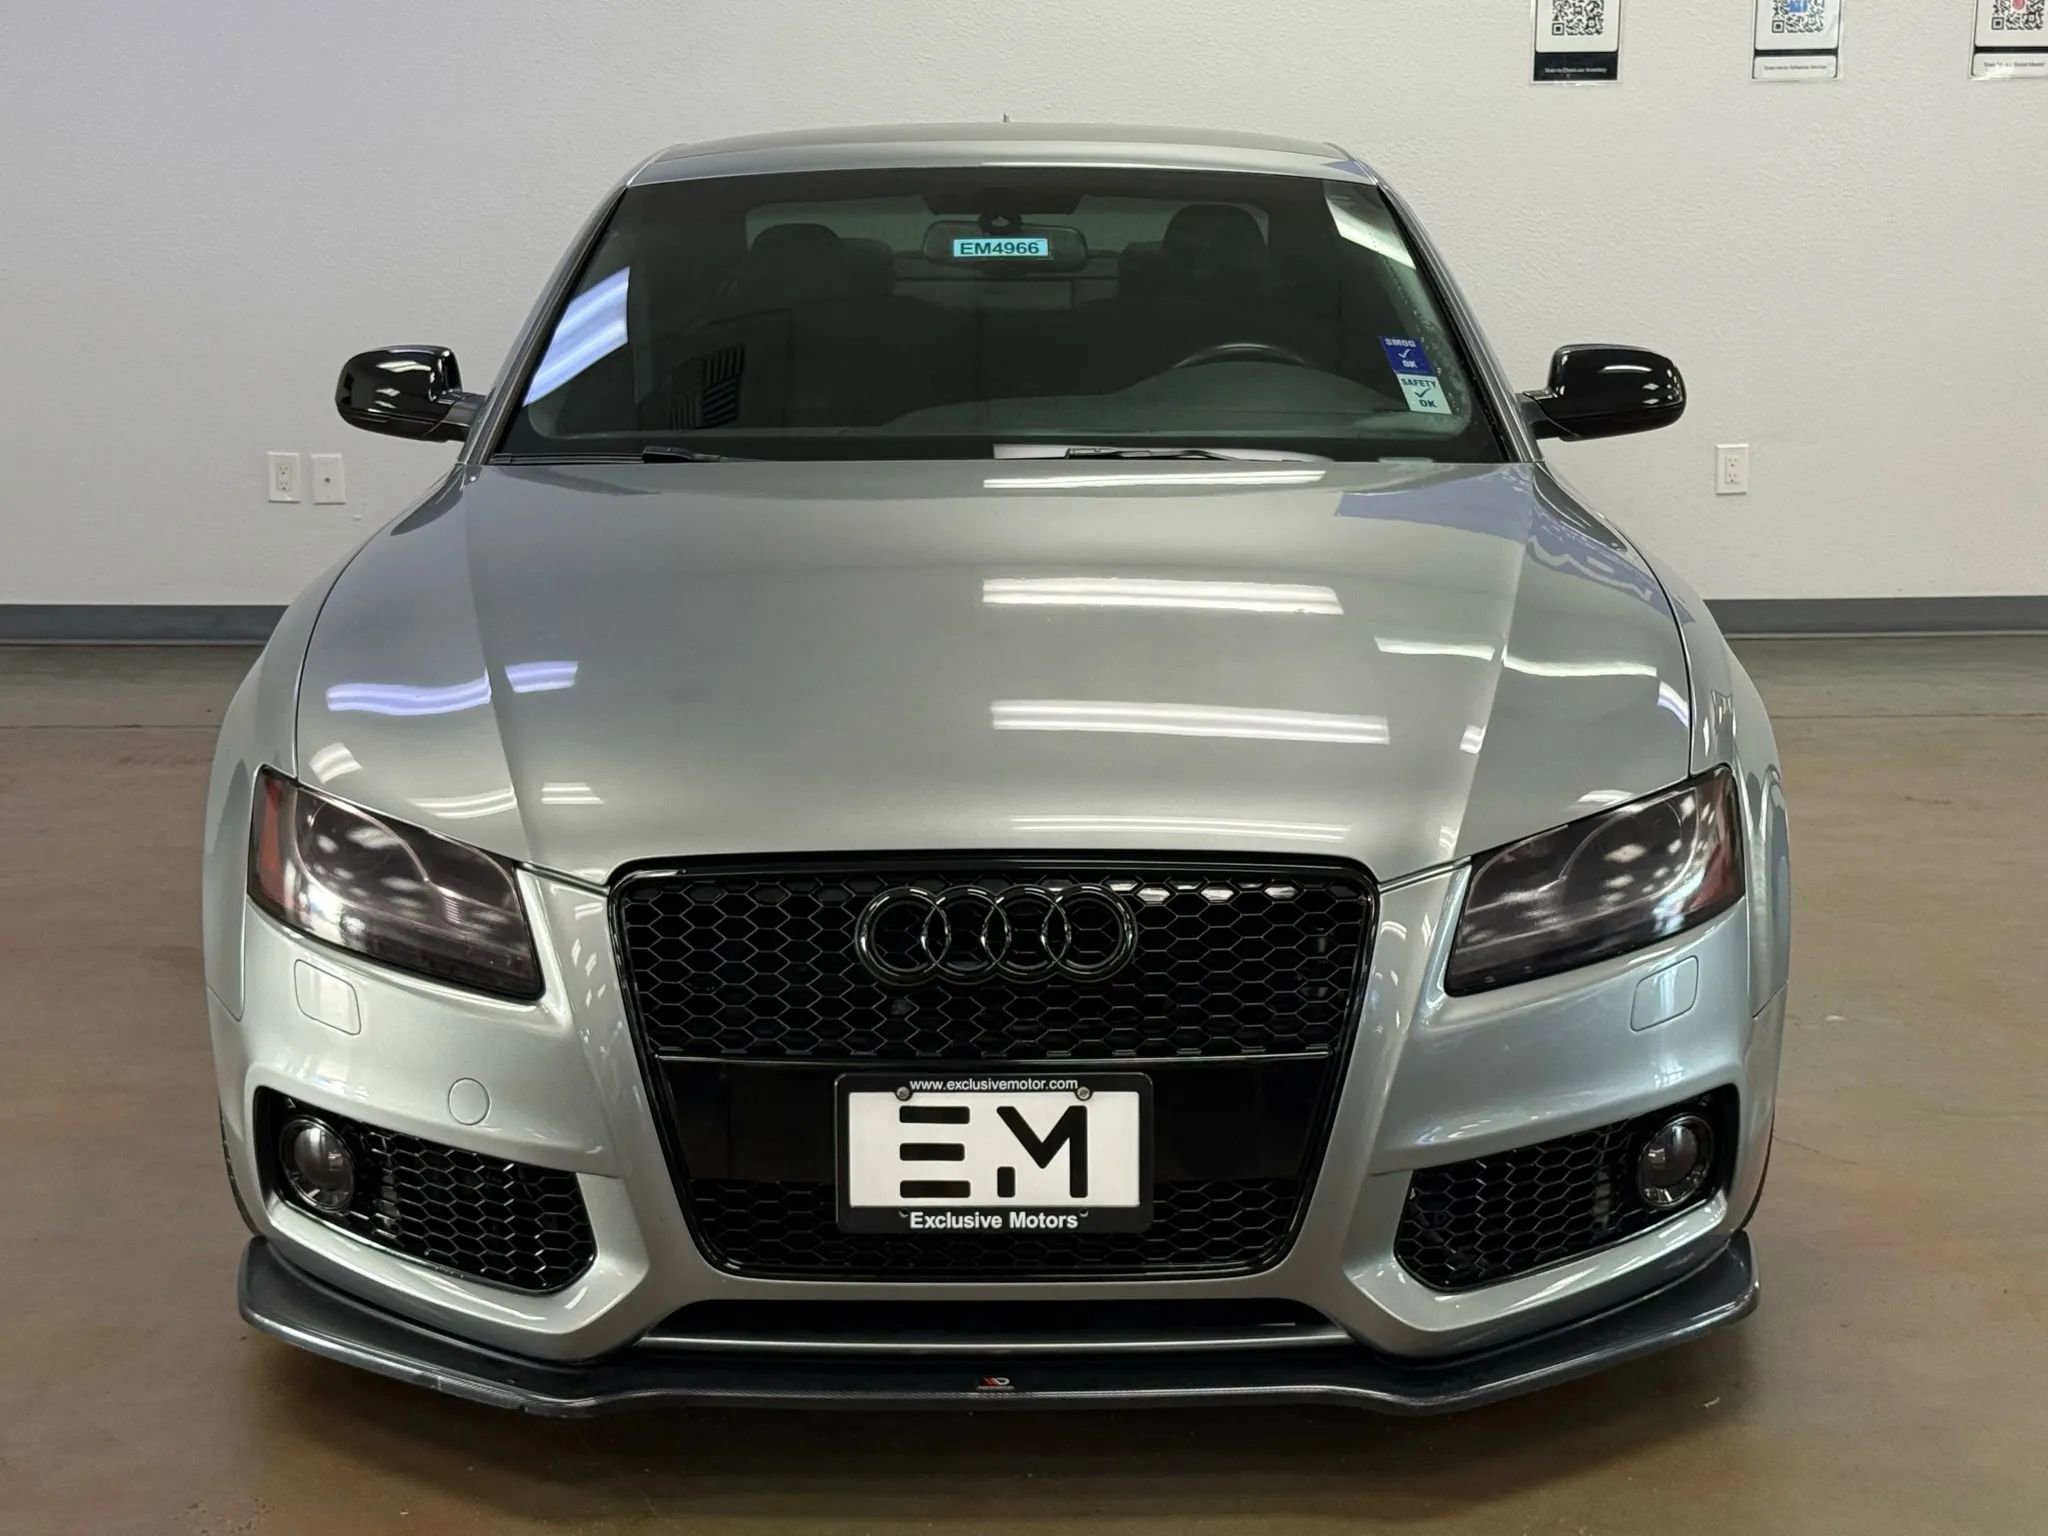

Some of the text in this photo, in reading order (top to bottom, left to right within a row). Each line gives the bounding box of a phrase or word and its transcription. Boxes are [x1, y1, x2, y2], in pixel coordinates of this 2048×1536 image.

[960, 242, 1039, 255] EM4966
[1385, 338, 1416, 348] SMOG
[1402, 360, 1418, 368] OK
[1401, 378, 1437, 388] SAFETY
[1419, 400, 1437, 408] OK
[910, 1078, 1079, 1091] www.exclusivemotor.com
[910, 1211, 1079, 1229] Exclusive Motors
